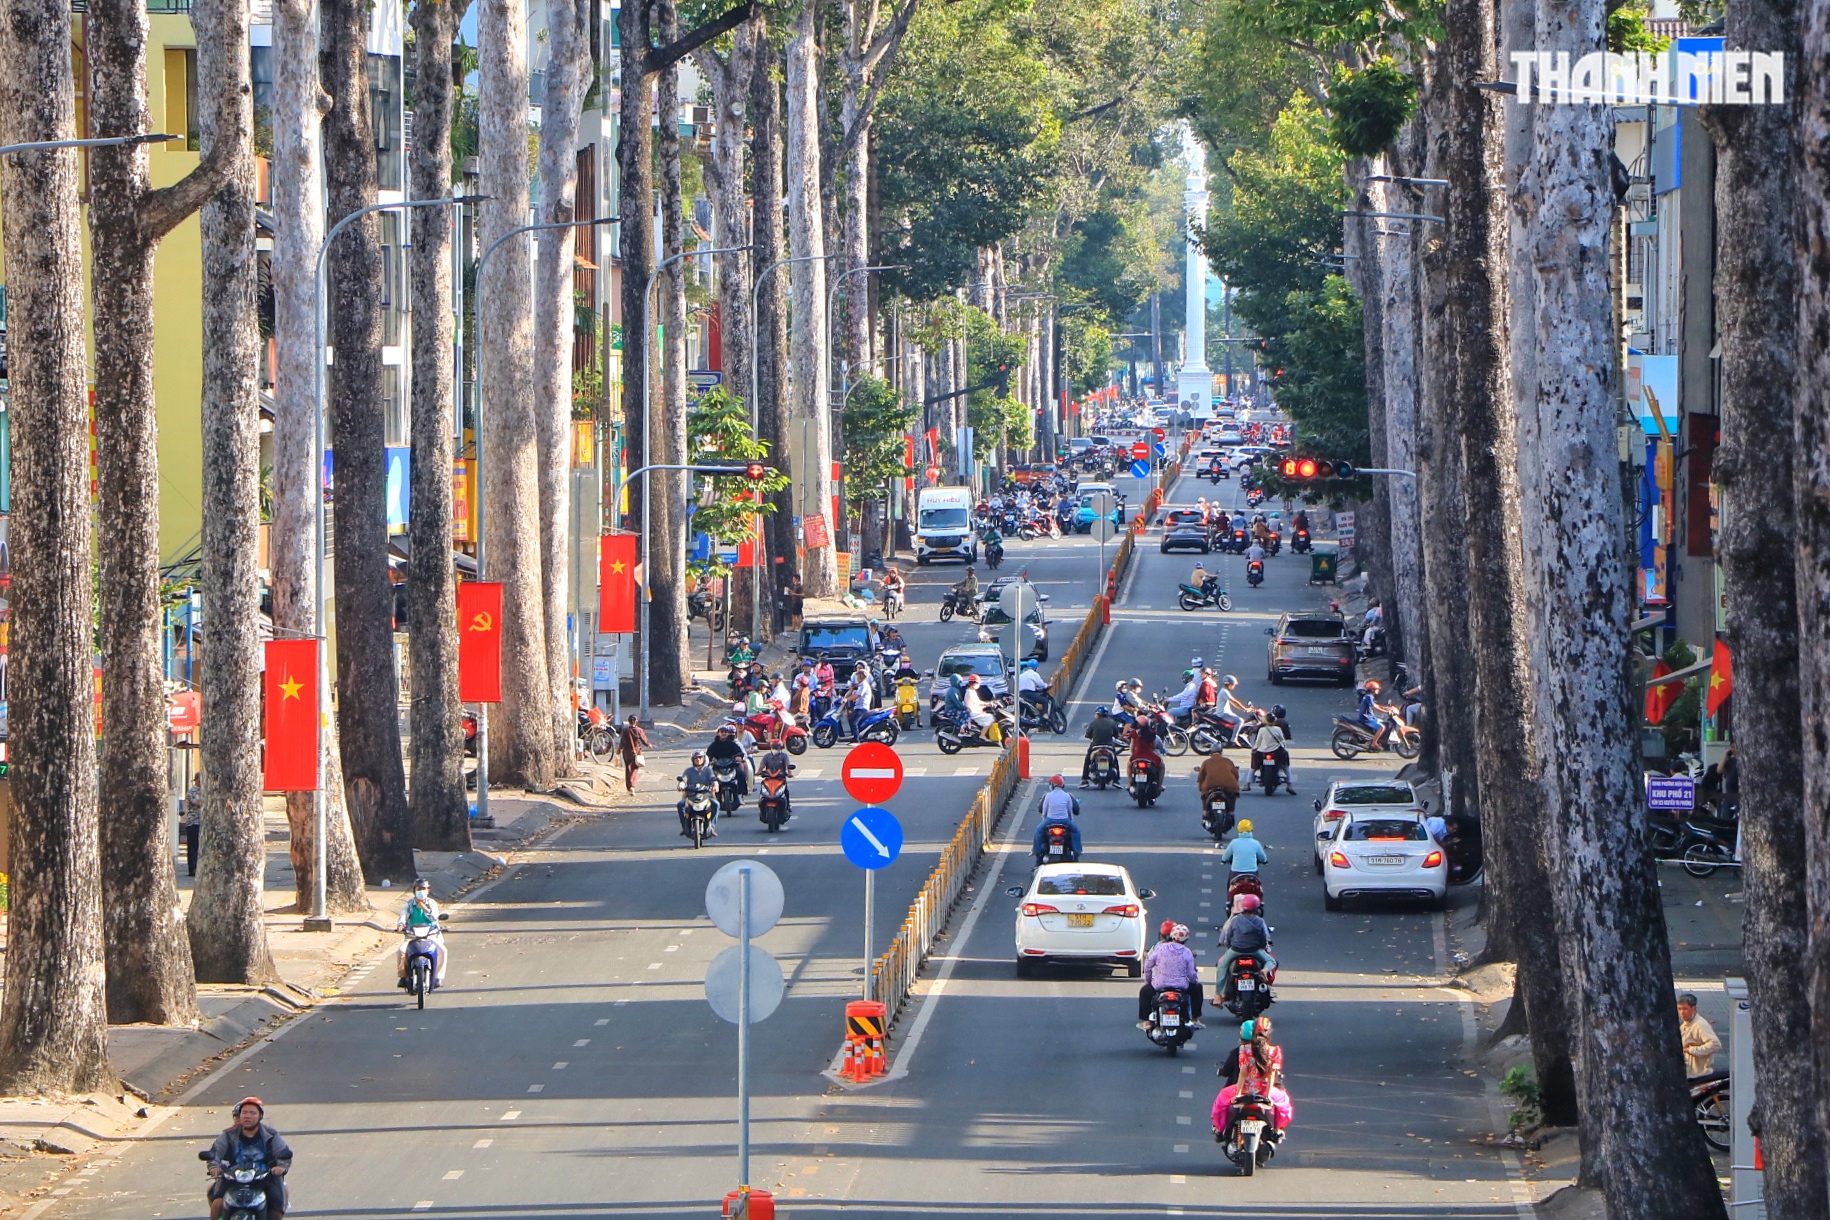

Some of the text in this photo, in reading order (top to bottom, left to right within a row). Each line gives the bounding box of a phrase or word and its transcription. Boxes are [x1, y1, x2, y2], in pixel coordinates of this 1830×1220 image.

[1651, 787, 1692, 799] KHU PHỐ 21
